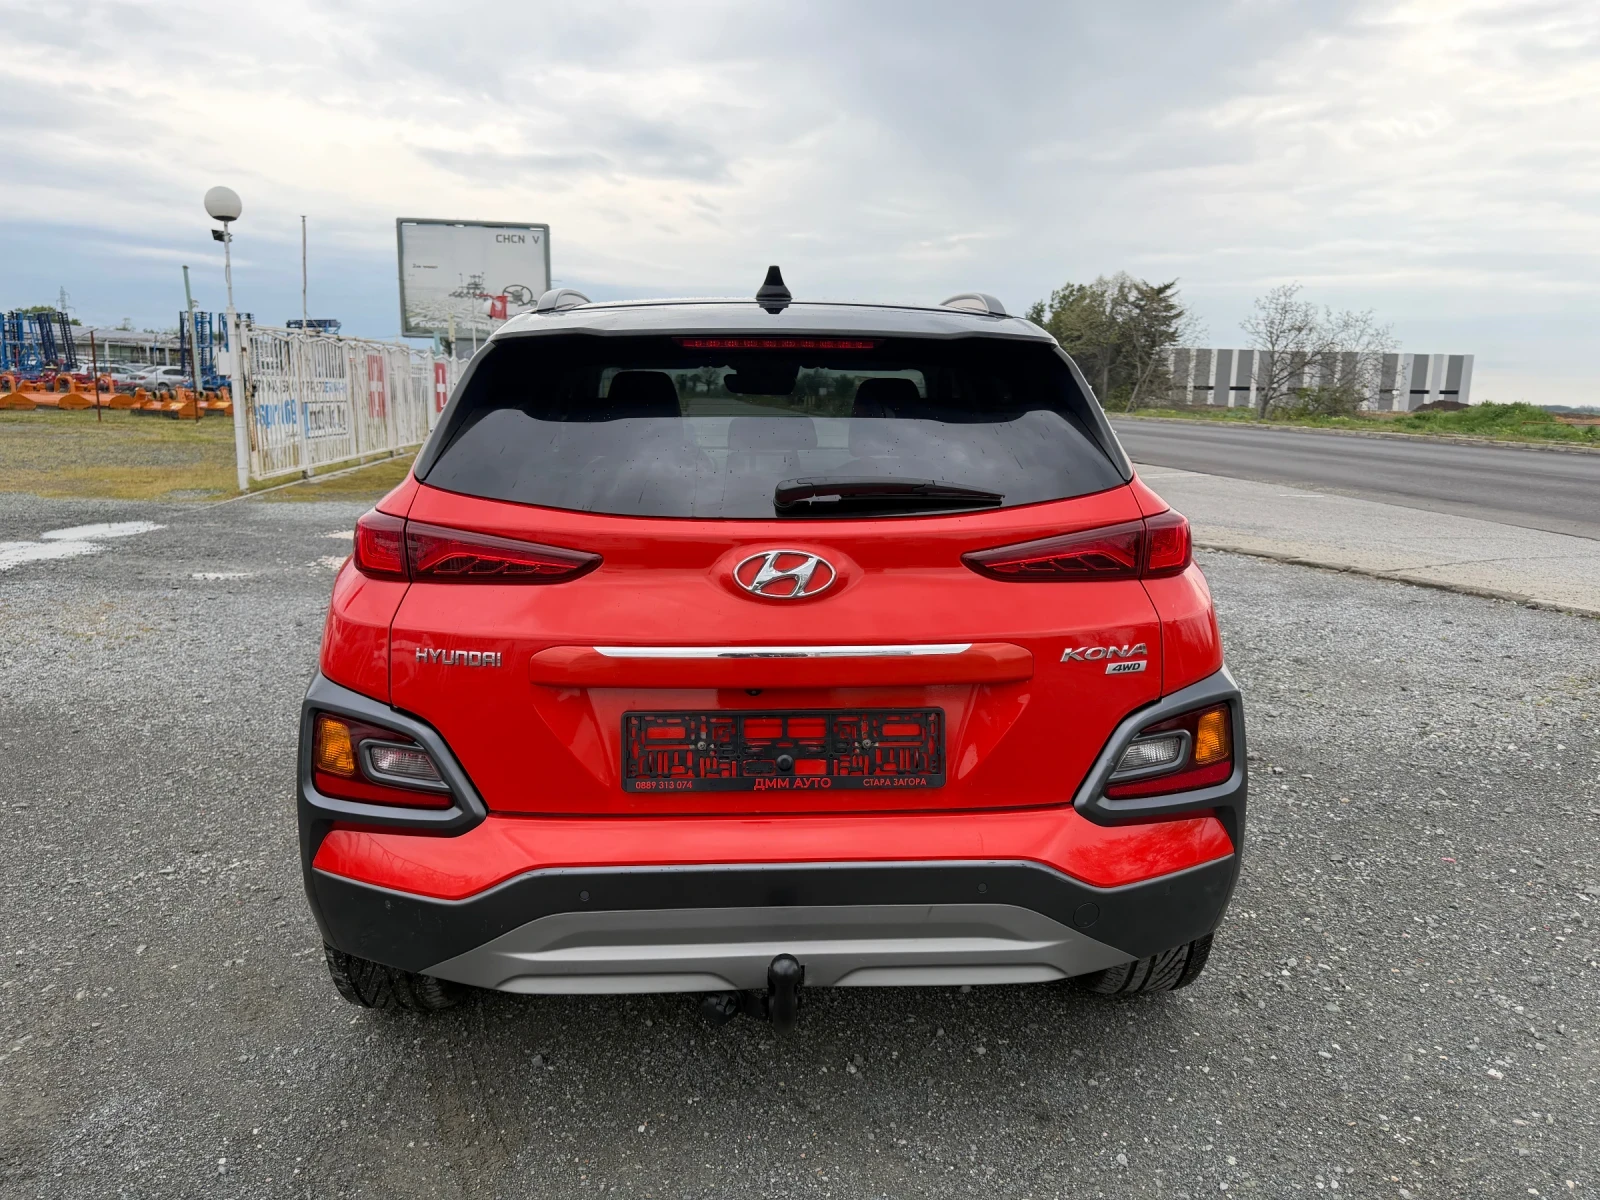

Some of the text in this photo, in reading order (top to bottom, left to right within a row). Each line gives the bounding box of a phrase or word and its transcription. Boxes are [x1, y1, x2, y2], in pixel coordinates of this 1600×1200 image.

[415, 647, 502, 667] HYUNDAI
[1059, 642, 1148, 662] KONA
[1112, 663, 1141, 672] 4WD
[636, 781, 693, 789] 0889 313 074
[753, 777, 832, 790] ДММ АУТО
[863, 777, 927, 787] СТАРА ЗАГОРА
